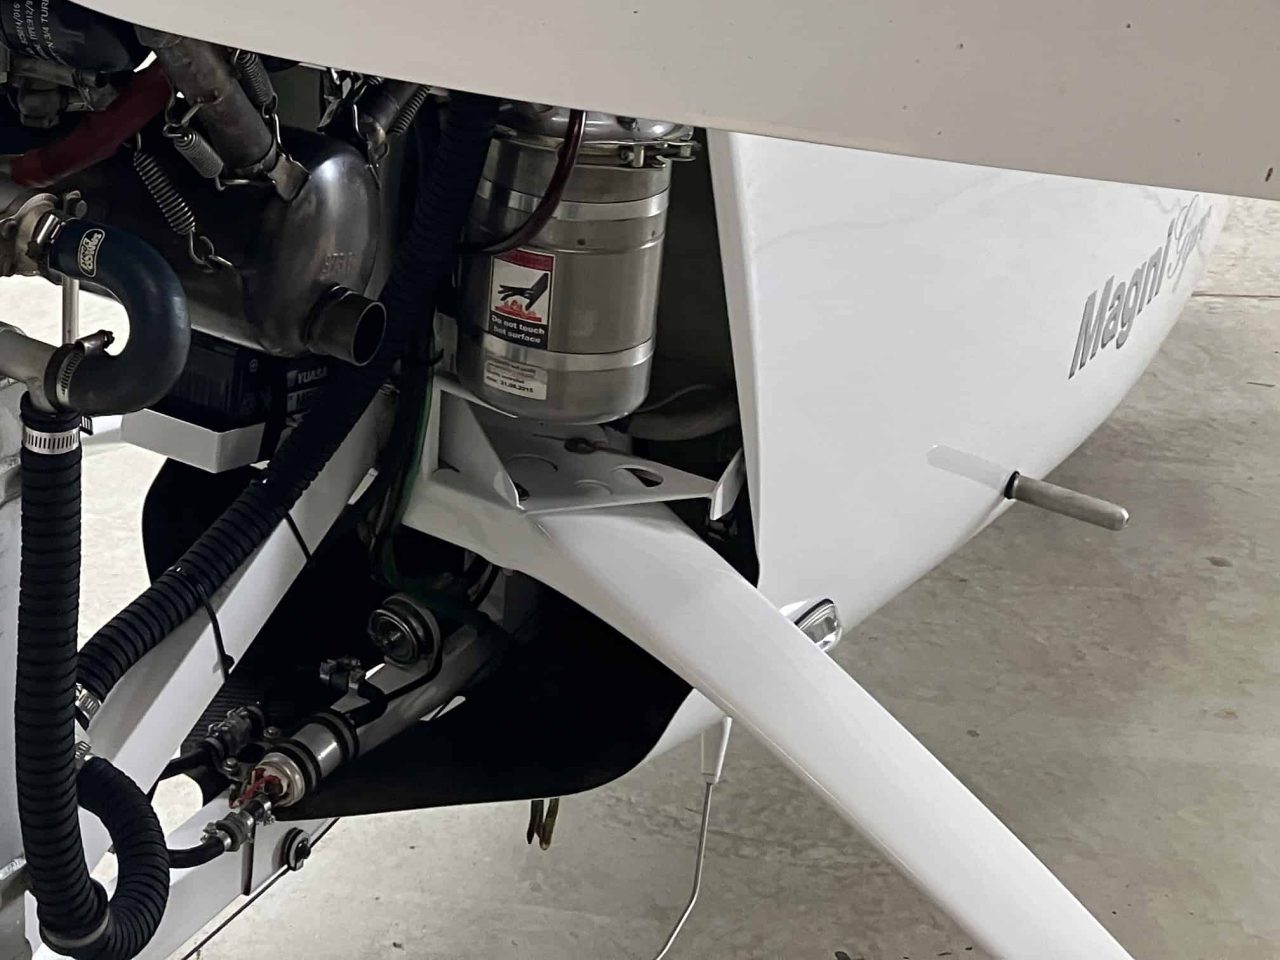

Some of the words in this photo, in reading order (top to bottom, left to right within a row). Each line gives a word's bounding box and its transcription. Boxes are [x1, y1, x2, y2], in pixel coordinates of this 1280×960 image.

[1068, 217, 1176, 379] Magni
[491, 314, 502, 324] Do
[504, 319, 518, 329] not
[519, 323, 545, 335] touch
[508, 330, 542, 344] surface
